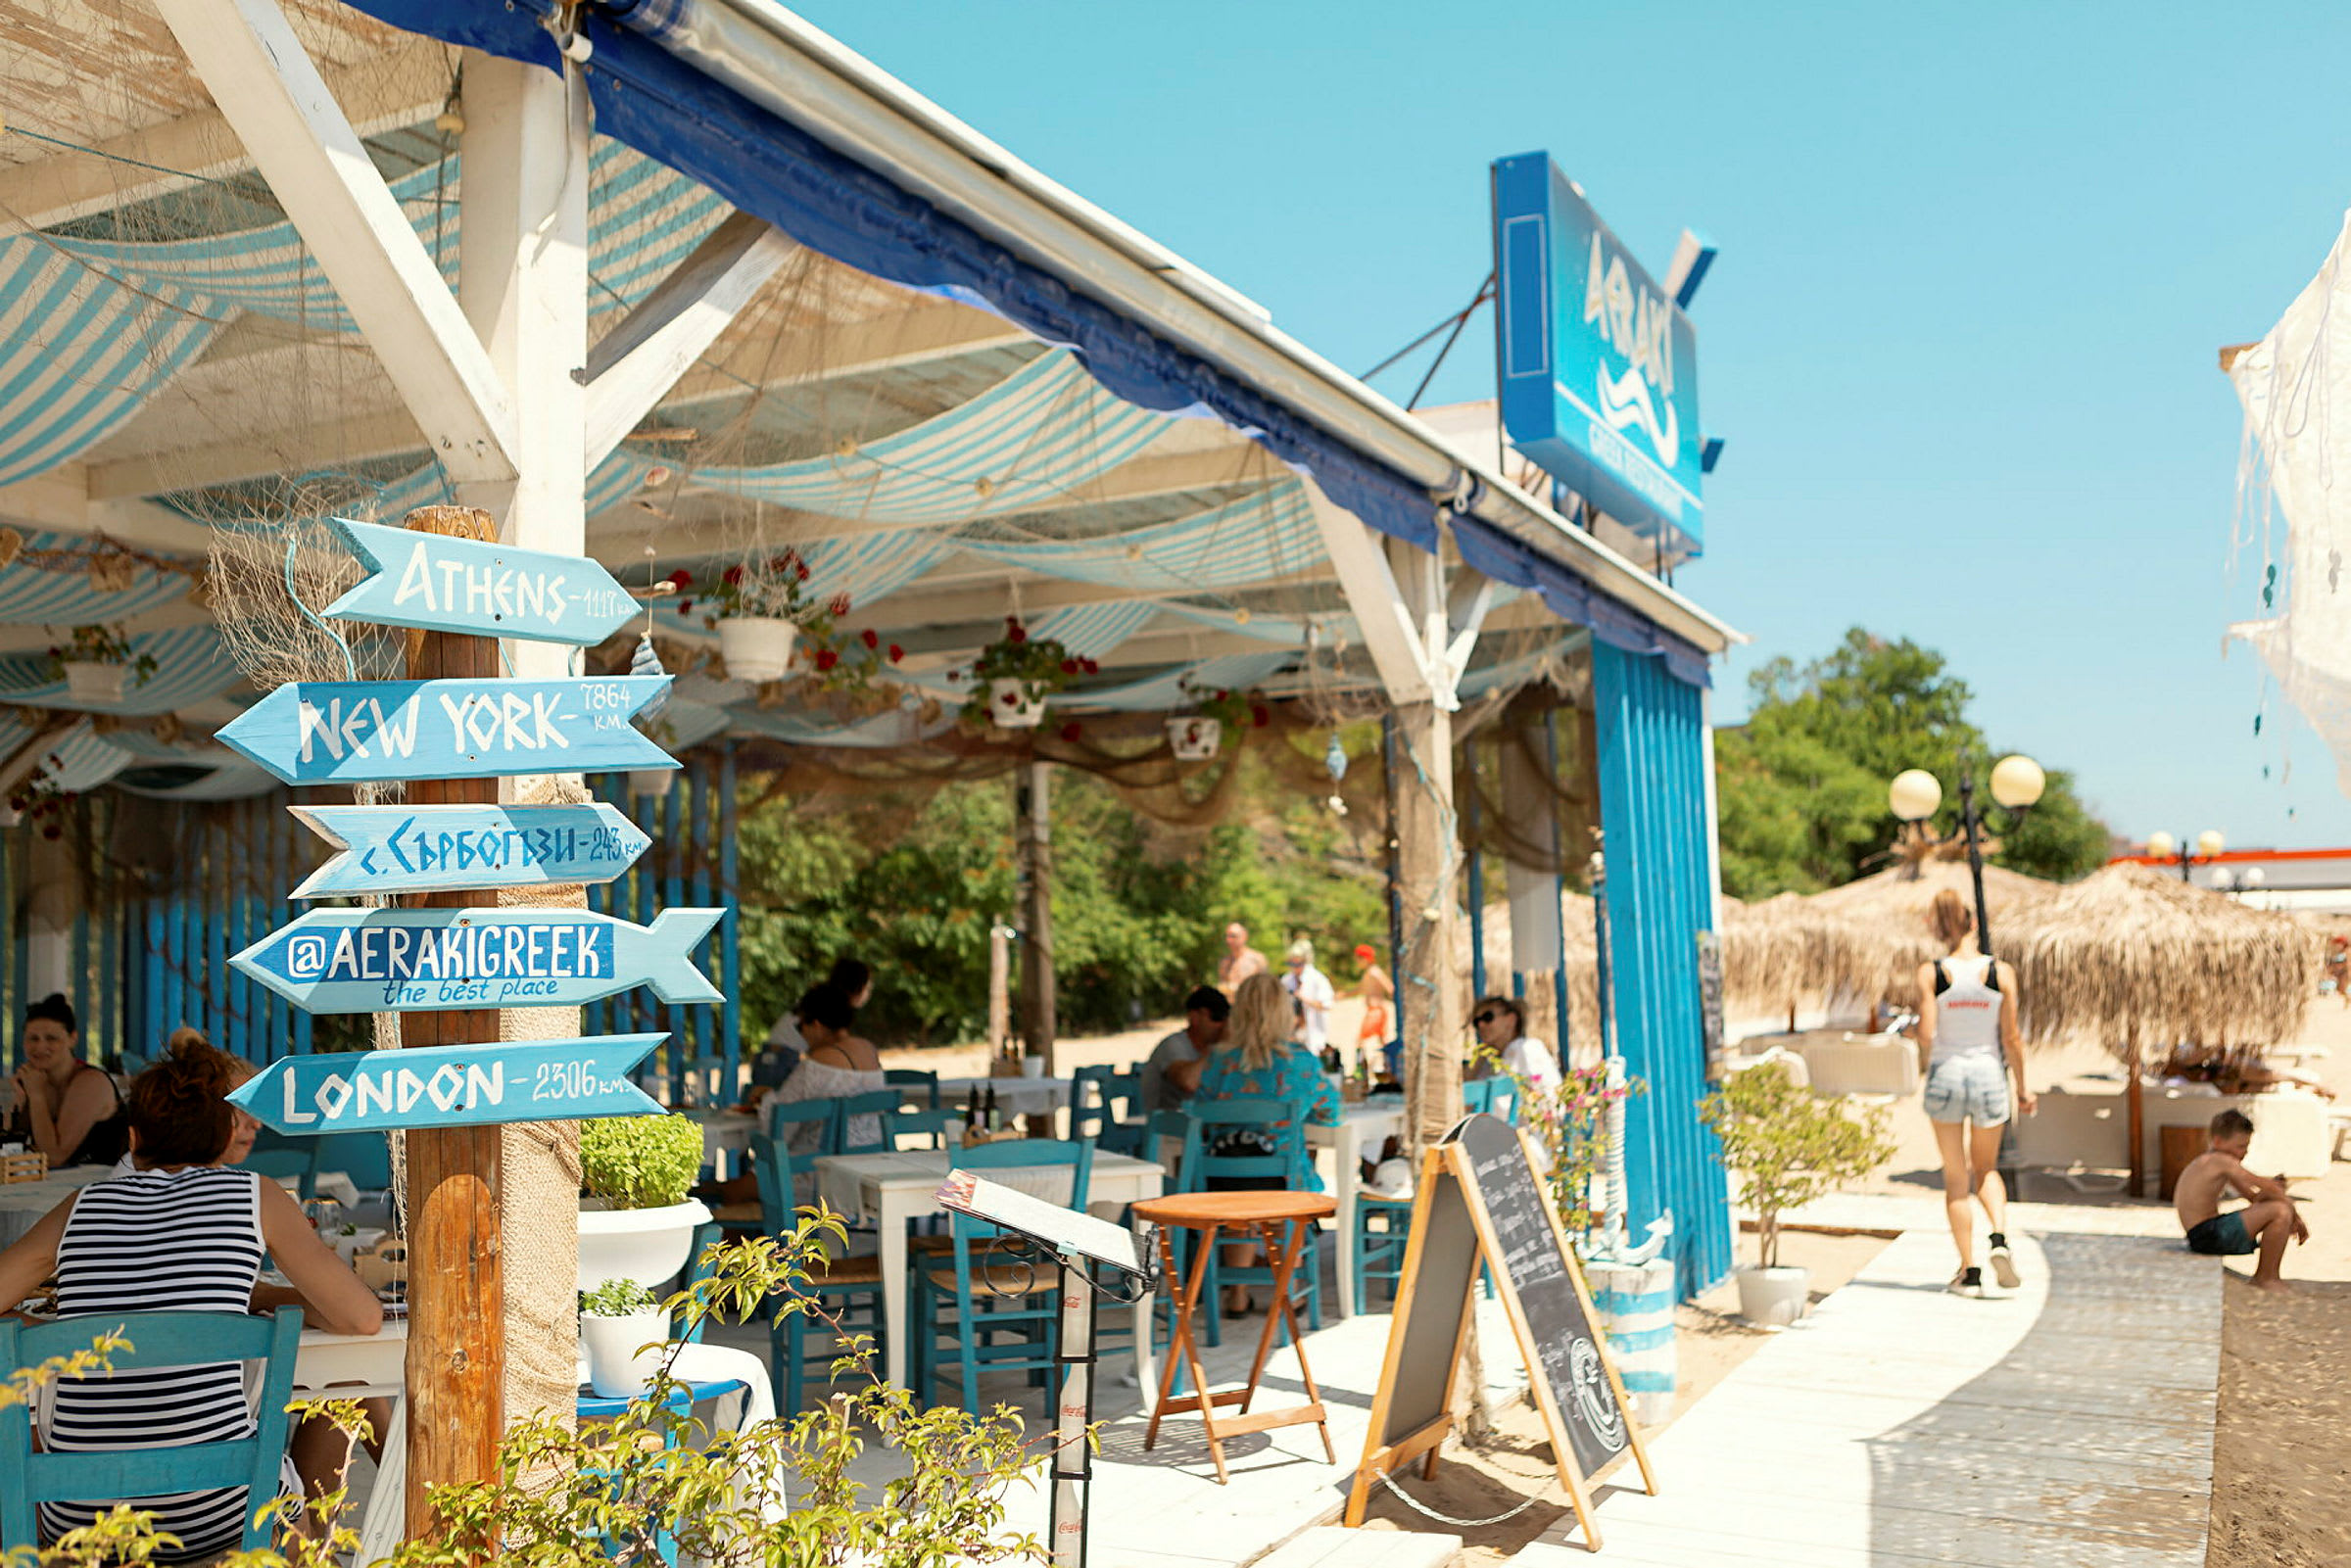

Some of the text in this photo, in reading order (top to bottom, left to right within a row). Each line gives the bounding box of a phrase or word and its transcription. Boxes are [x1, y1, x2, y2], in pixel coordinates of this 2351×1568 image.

[580, 683, 631, 710] 7864
[298, 693, 420, 764] NEW
[287, 925, 600, 979] @AERAKIGREEK
[382, 978, 558, 1006] the best place
[283, 1061, 504, 1123] LONDON
[532, 1060, 597, 1102] 2306
